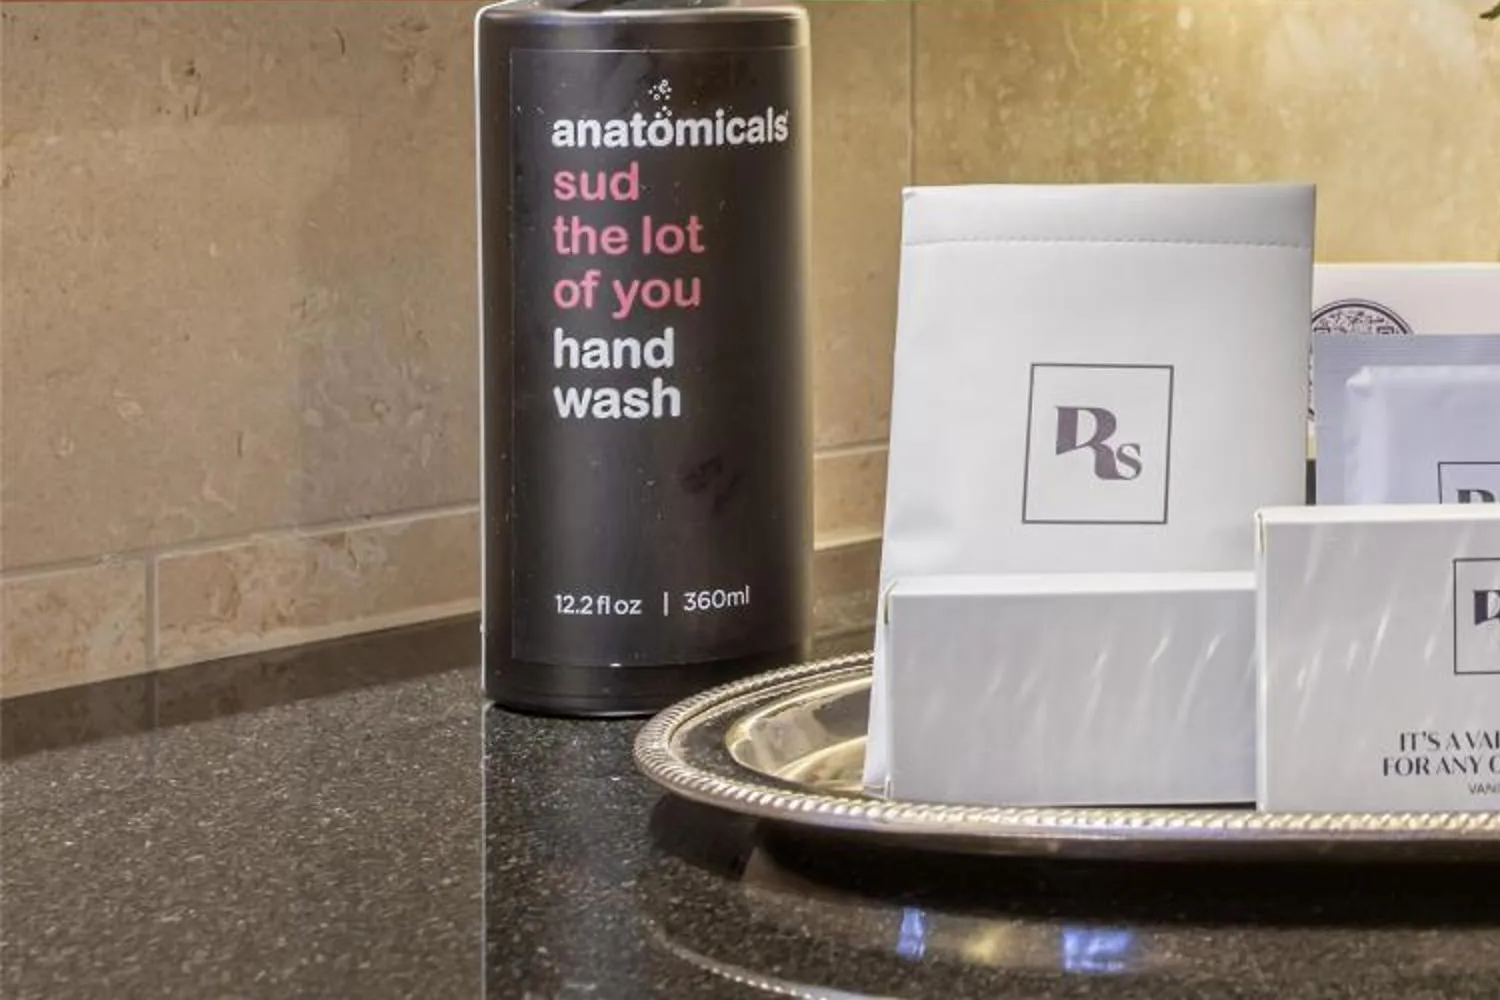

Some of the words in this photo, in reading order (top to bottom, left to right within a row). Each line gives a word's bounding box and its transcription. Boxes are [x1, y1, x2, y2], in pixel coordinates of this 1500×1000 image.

[553, 161, 640, 201] sud
[553, 215, 628, 255] the
[642, 215, 705, 254] lot
[553, 269, 600, 309] of
[611, 277, 701, 320] you
[553, 327, 675, 369] hand
[553, 377, 681, 419] wash
[683, 585, 750, 612] 360ml
[1400, 731, 1441, 752] IT'S
[1446, 731, 1461, 751] A
[1383, 756, 1430, 777] FOR
[1435, 755, 1484, 776] ANY
